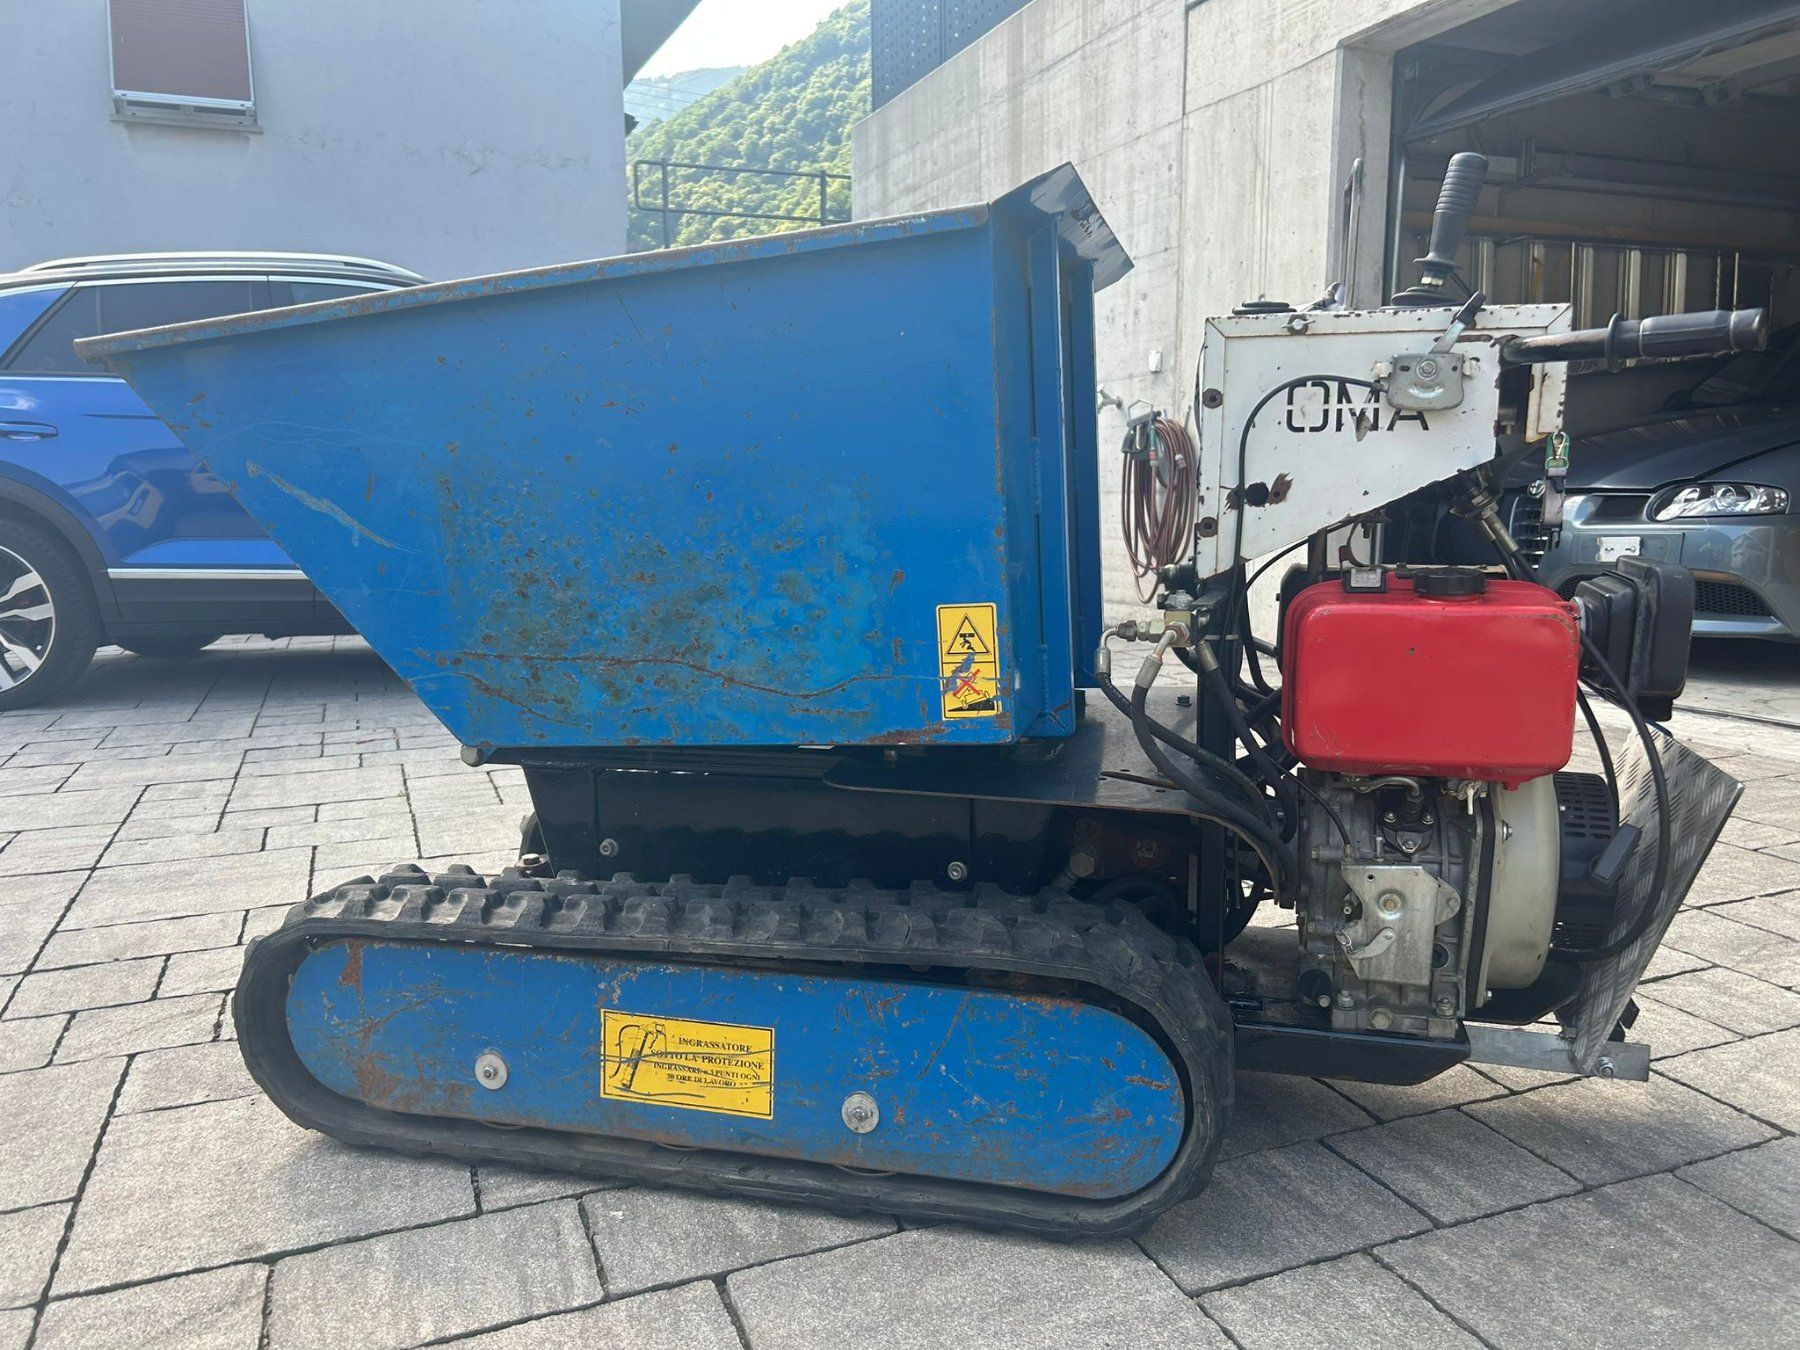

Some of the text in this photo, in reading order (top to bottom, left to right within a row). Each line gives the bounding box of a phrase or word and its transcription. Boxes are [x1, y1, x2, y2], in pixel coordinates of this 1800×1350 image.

[678, 1037, 752, 1053] INGRASSATORE
[650, 1049, 765, 1071] SOTTO LA PROTEZIONE
[676, 1074, 692, 1082] ORE
[703, 1077, 736, 1087] LAVORO
[715, 1069, 739, 1079] PUNTI
[740, 1072, 761, 1081] OGNI
